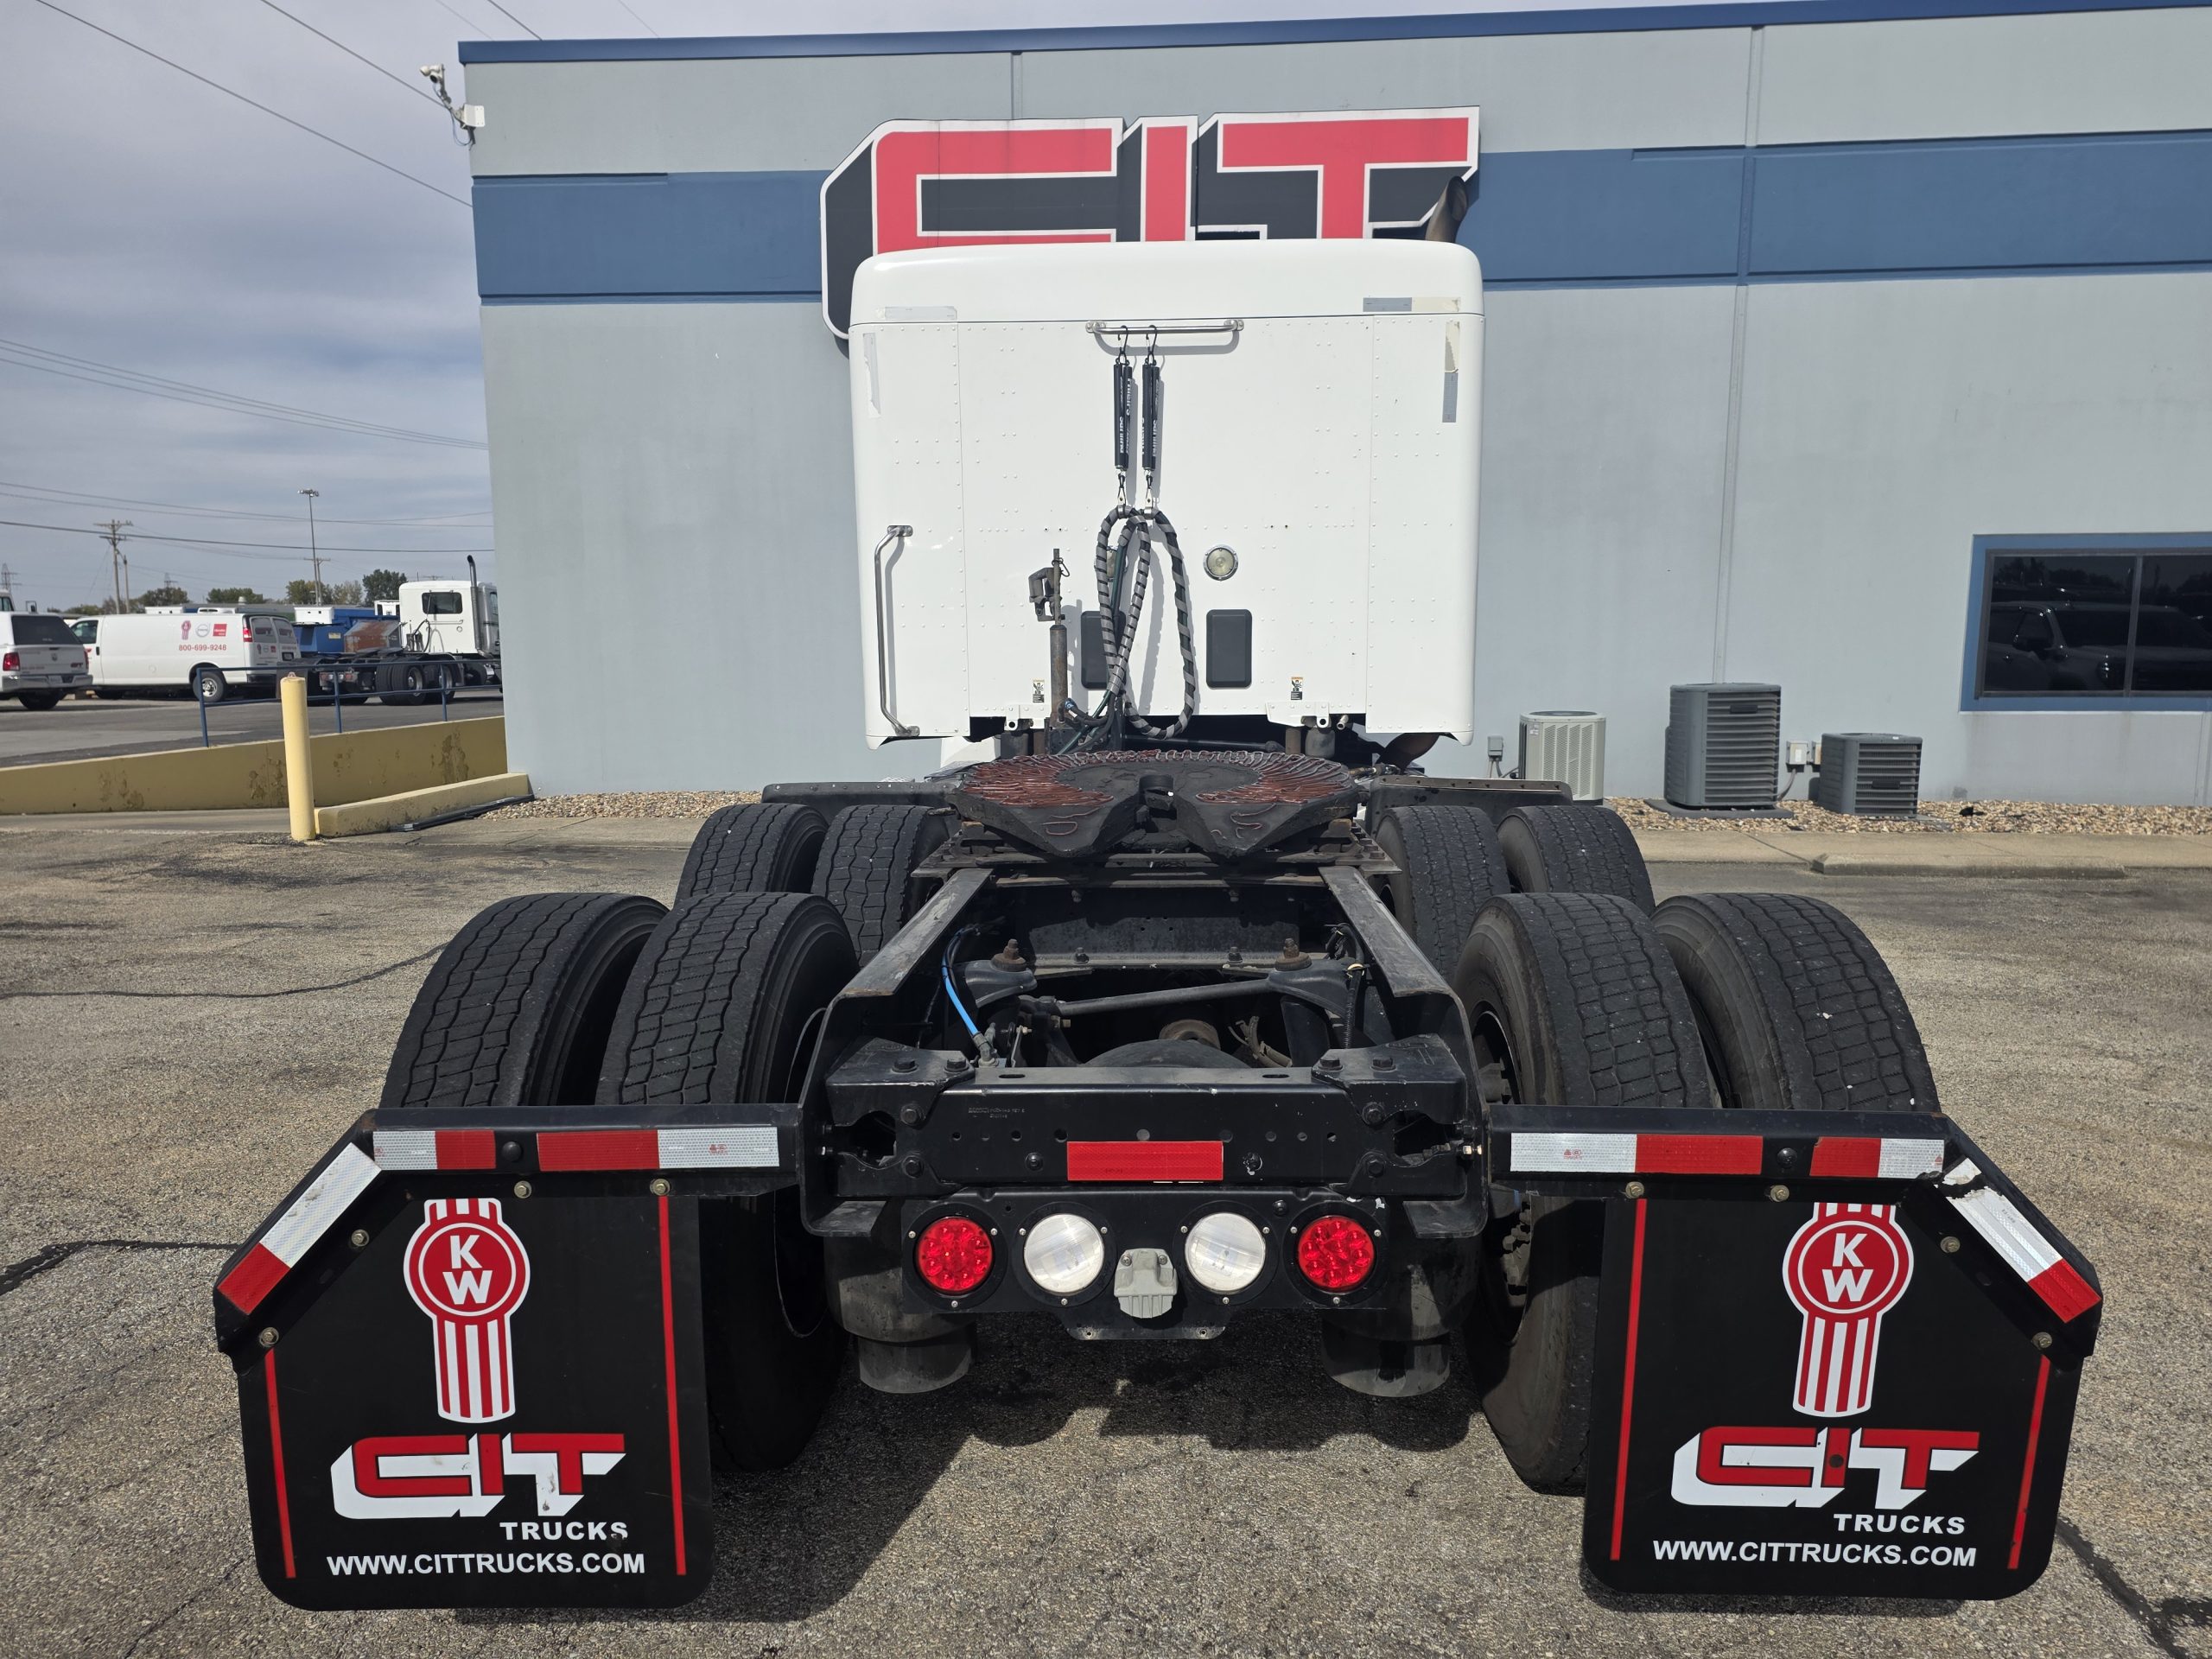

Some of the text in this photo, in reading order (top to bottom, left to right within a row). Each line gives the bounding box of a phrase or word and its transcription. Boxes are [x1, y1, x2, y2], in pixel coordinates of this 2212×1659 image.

[822, 106, 1481, 270] CIT
[330, 1432, 627, 1520] CIT
[1670, 1425, 1980, 1510] CIT
[499, 1521, 629, 1541] TRUCKS
[1833, 1513, 1966, 1535] TRUCKS
[326, 1552, 646, 1576] WWW.CITTRUCKS.COM
[1652, 1539, 1977, 1567] WWW.CITTRUCKS.COM
